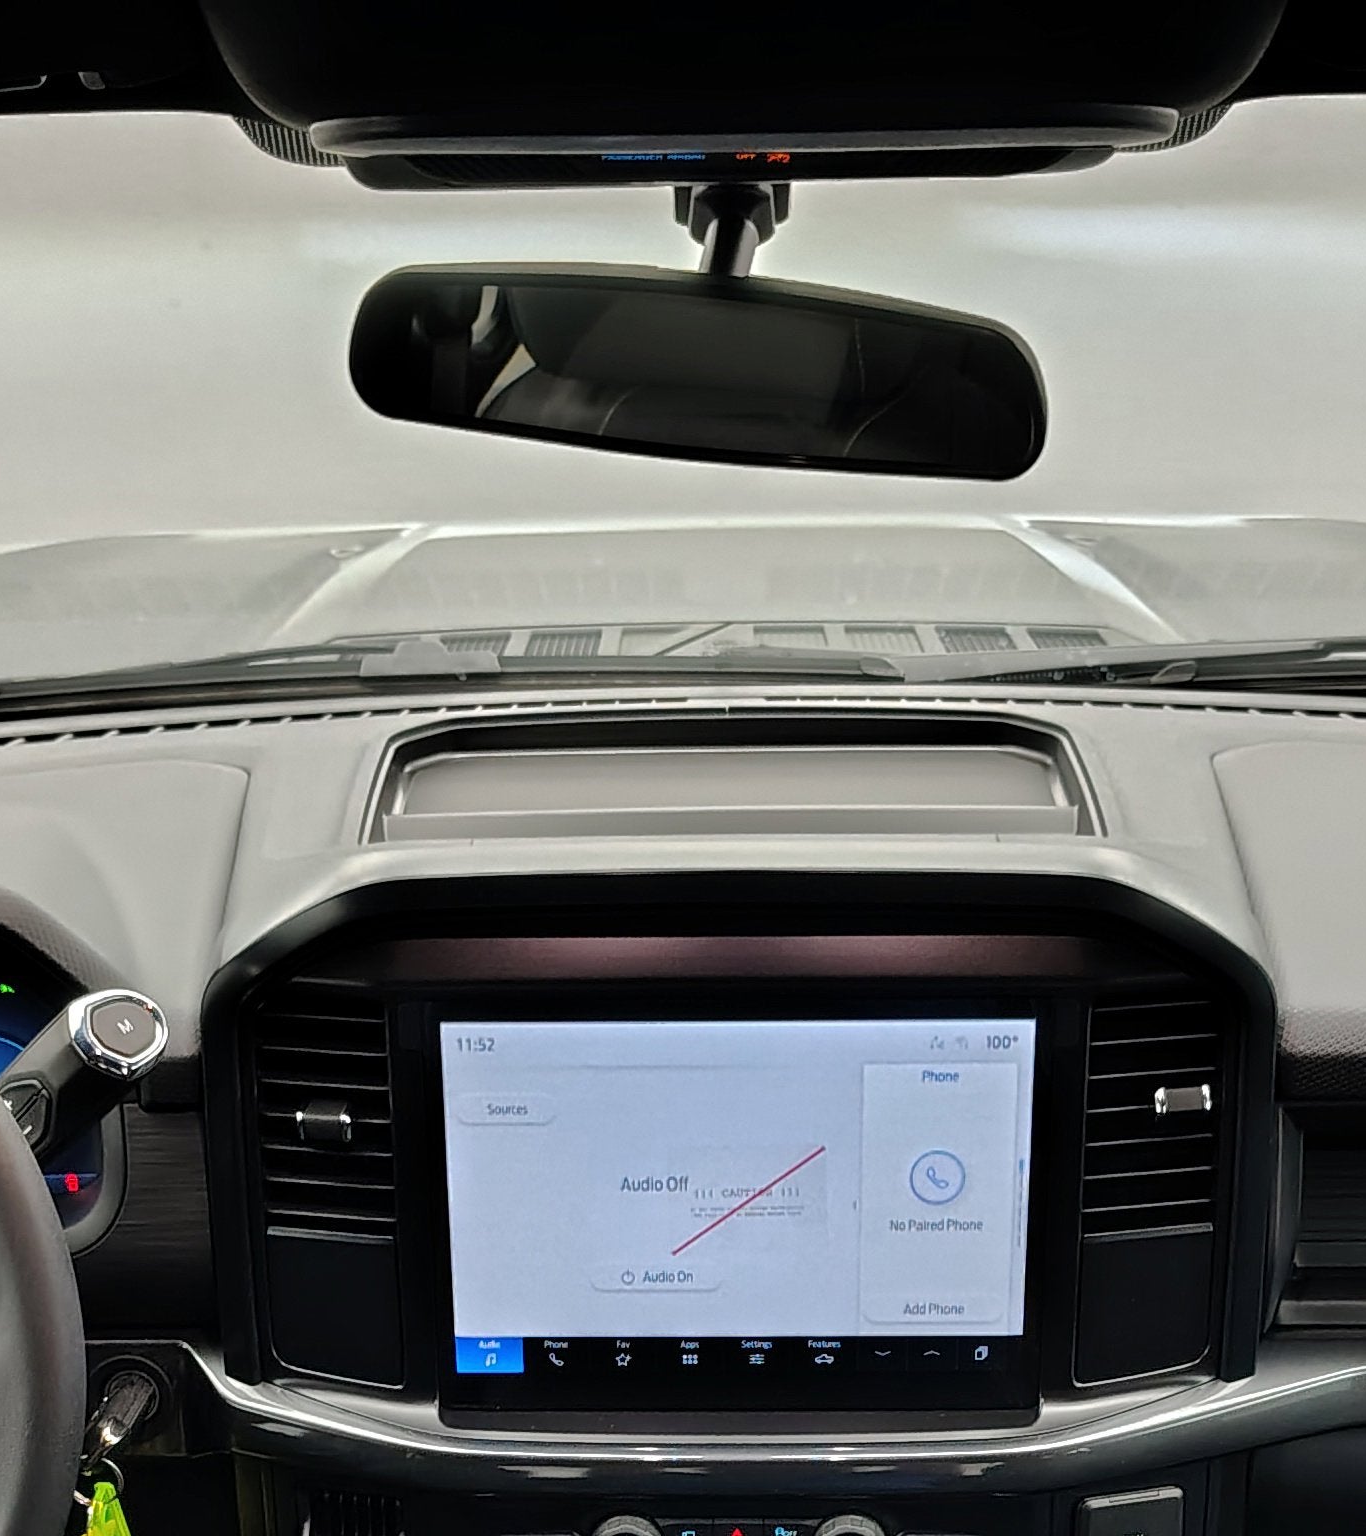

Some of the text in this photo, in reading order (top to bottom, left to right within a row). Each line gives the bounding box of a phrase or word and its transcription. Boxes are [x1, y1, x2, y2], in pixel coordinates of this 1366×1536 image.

[117, 1018, 134, 1035] M
[456, 1037, 496, 1052] 11:52
[922, 1070, 960, 1083] Phone
[486, 1103, 528, 1115] Sources
[620, 1175, 689, 1192] Audio Off
[890, 1218, 983, 1232] No Paired Phone
[643, 1270, 694, 1283] Audio On
[903, 1302, 965, 1315] Add Phone
[544, 1340, 569, 1349] Phone
[616, 1340, 631, 1349] Fav
[680, 1340, 700, 1350] Apps
[741, 1340, 773, 1350] Settings
[807, 1340, 842, 1349] Features
